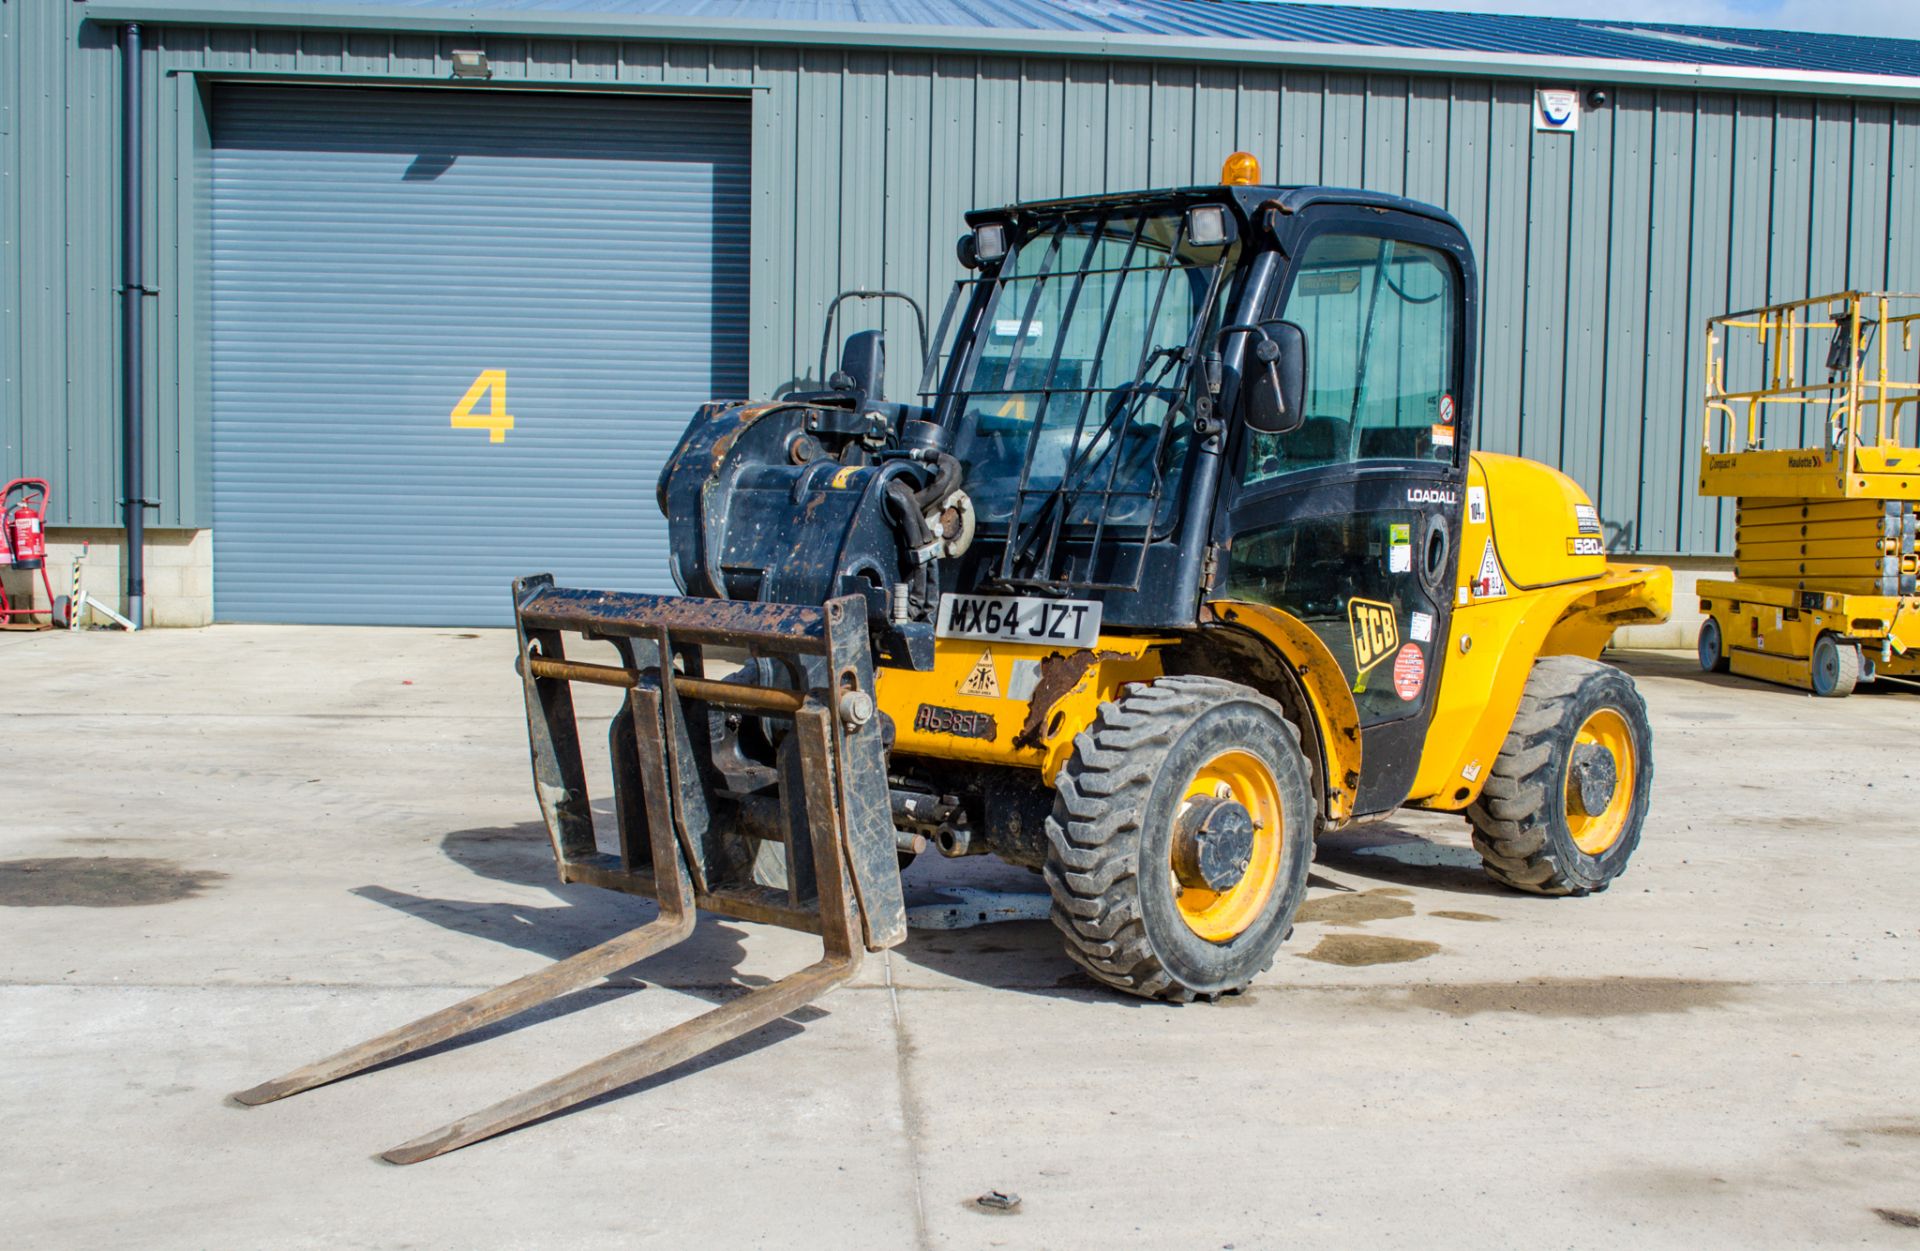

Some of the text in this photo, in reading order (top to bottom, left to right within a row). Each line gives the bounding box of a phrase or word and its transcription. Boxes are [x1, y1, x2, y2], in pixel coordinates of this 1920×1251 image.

[450, 369, 514, 443] 4
[1407, 489, 1457, 504] LOADALL
[949, 598, 1089, 640] MX64 JZT
[1356, 606, 1395, 665] JCB
